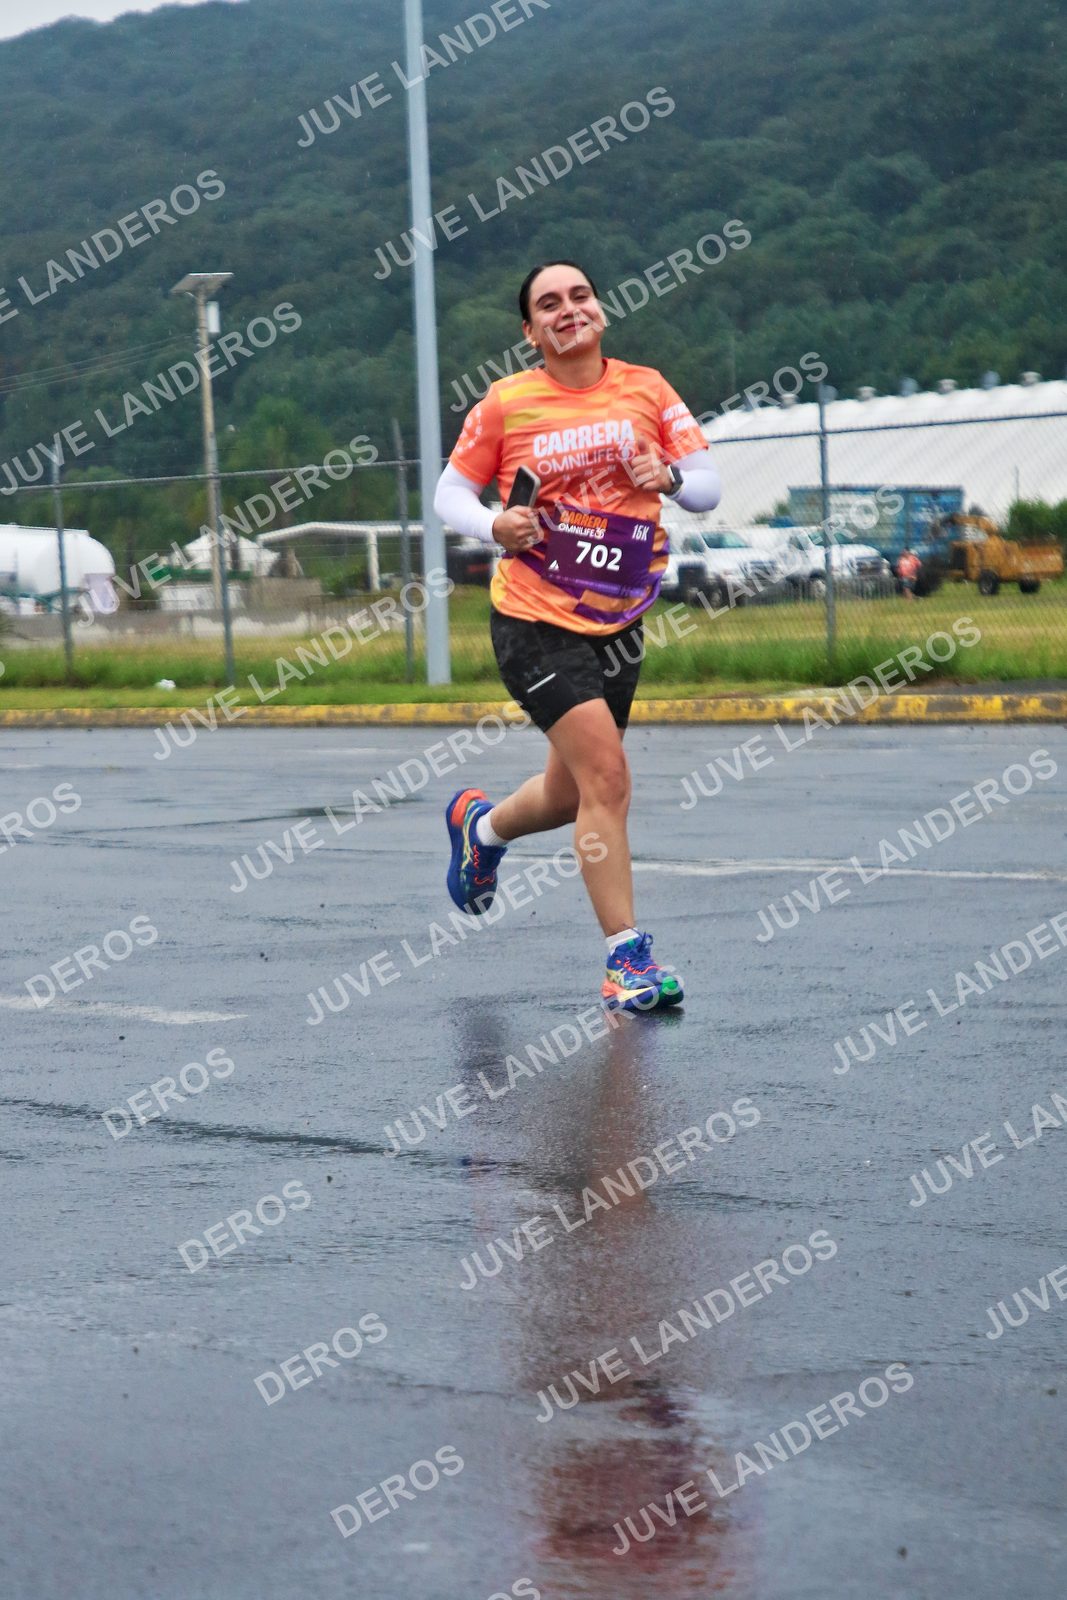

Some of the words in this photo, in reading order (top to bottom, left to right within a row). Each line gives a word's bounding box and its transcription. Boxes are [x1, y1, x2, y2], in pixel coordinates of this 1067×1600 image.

[533, 419, 635, 458] CARRERA
[560, 510, 609, 529] CARRERA
[632, 524, 650, 541] 15K
[575, 540, 623, 572] 702
